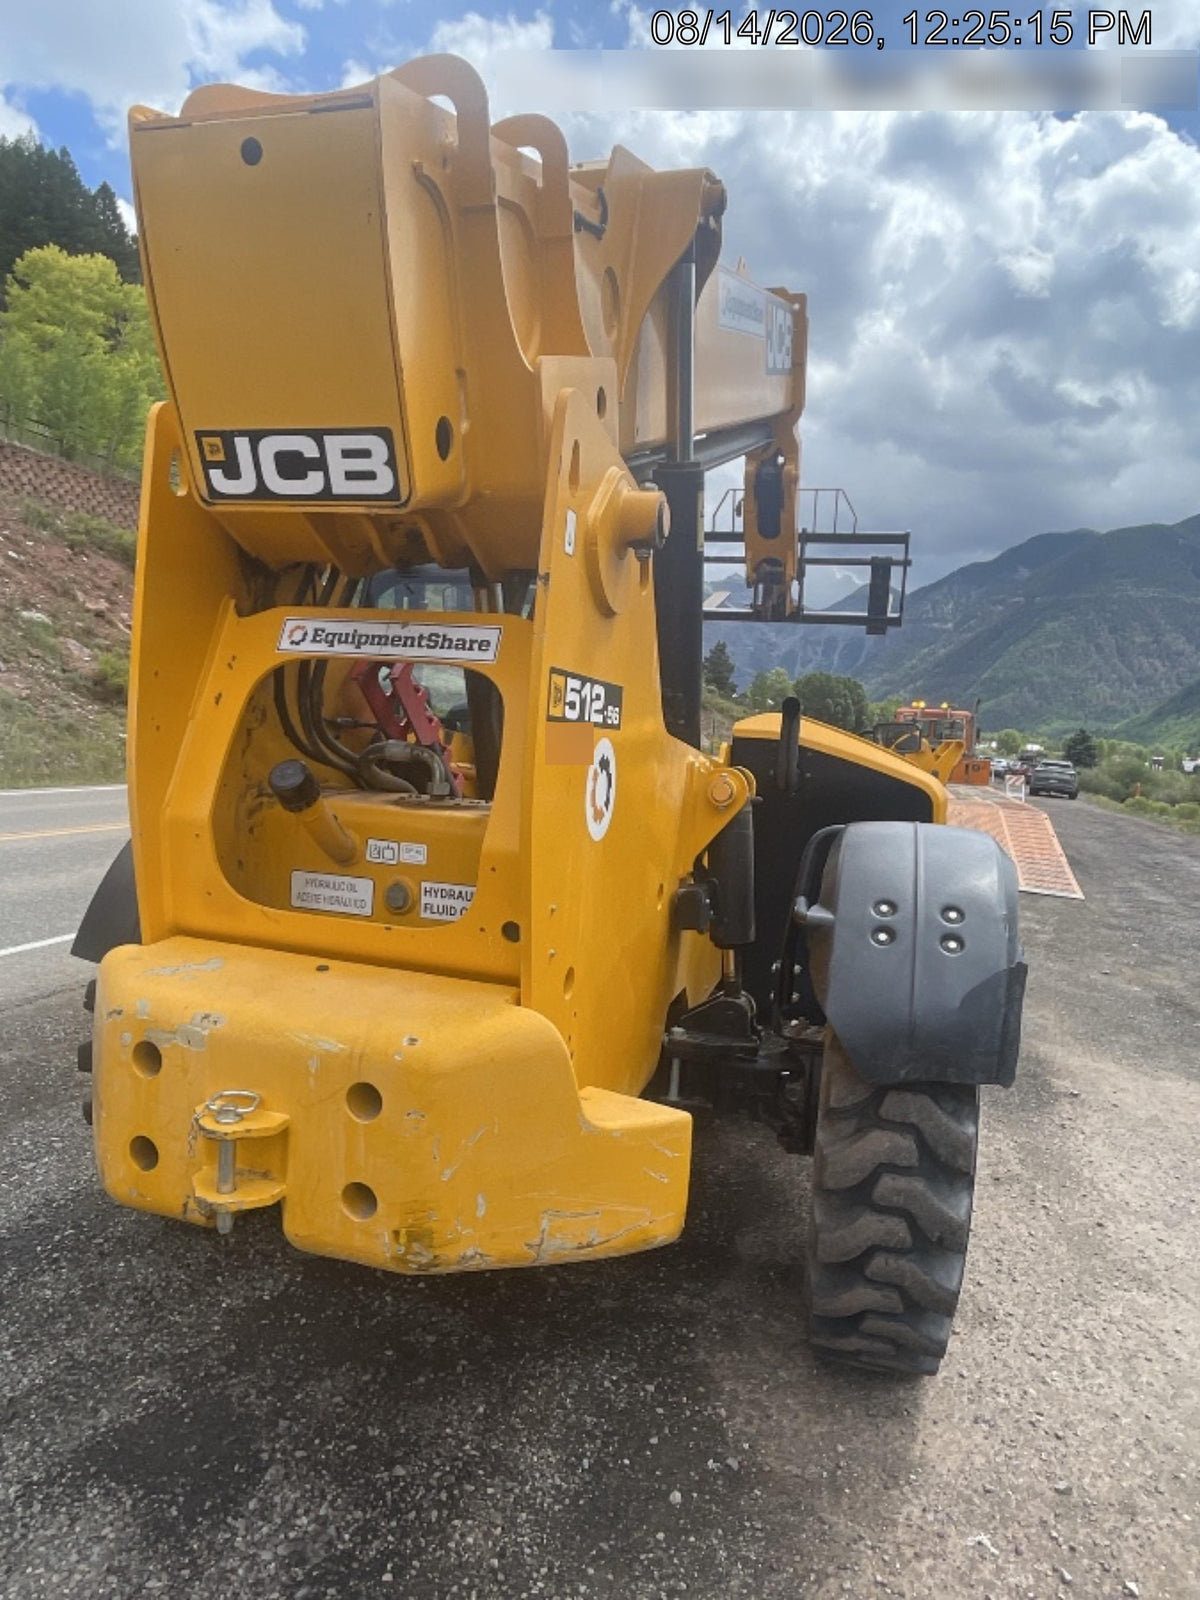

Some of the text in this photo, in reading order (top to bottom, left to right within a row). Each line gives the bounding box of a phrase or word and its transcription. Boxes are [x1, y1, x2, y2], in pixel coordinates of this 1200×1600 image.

[208, 434, 395, 495] JCB
[310, 627, 492, 653] EquipmentShare
[304, 877, 346, 892] HYDRAULIC
[423, 902, 457, 916] FLUID
